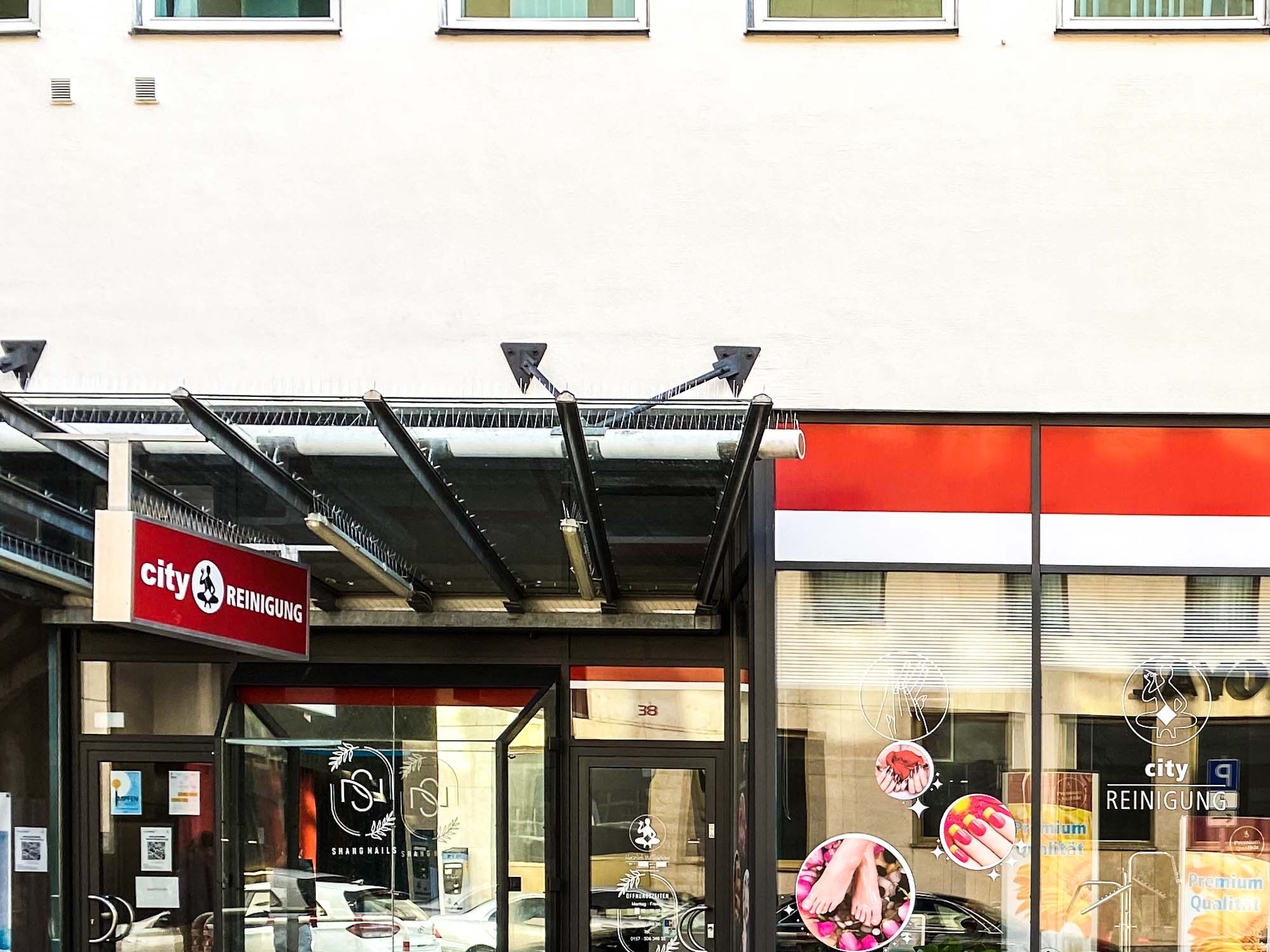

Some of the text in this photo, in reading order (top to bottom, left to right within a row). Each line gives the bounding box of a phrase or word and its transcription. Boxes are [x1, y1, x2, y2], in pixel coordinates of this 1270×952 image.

[140, 558, 303, 624] city REINIGUNG
[637, 704, 658, 716] 38
[1144, 757, 1189, 782] city
[1105, 789, 1228, 812] REINIGUNG
[331, 846, 398, 856] SHANG NAILS
[1188, 873, 1263, 890] Premium
[1190, 895, 1260, 913] Qualität
